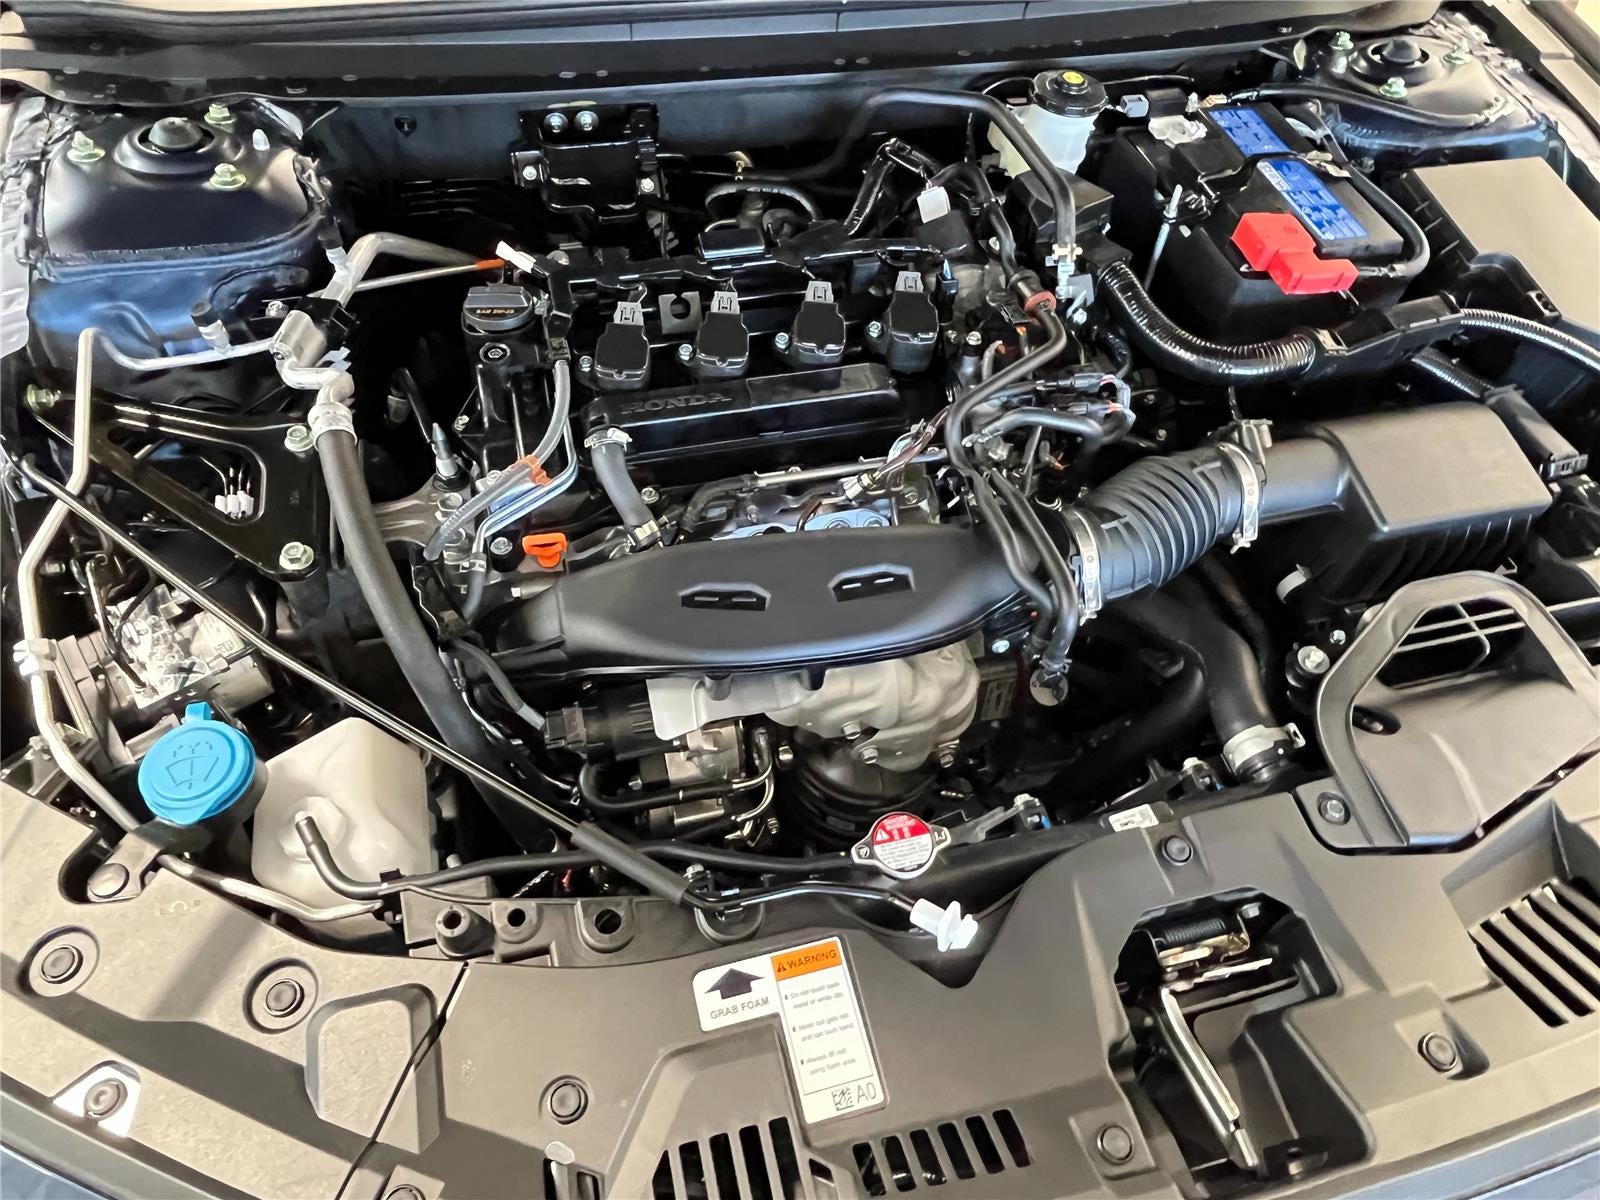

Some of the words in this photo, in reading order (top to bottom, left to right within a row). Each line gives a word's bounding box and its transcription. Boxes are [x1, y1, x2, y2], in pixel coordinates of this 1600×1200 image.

[620, 392, 732, 415] HONDA
[786, 949, 838, 970] WARNING
[710, 1004, 739, 1020] GRAB
[741, 996, 770, 1012] FOAM
